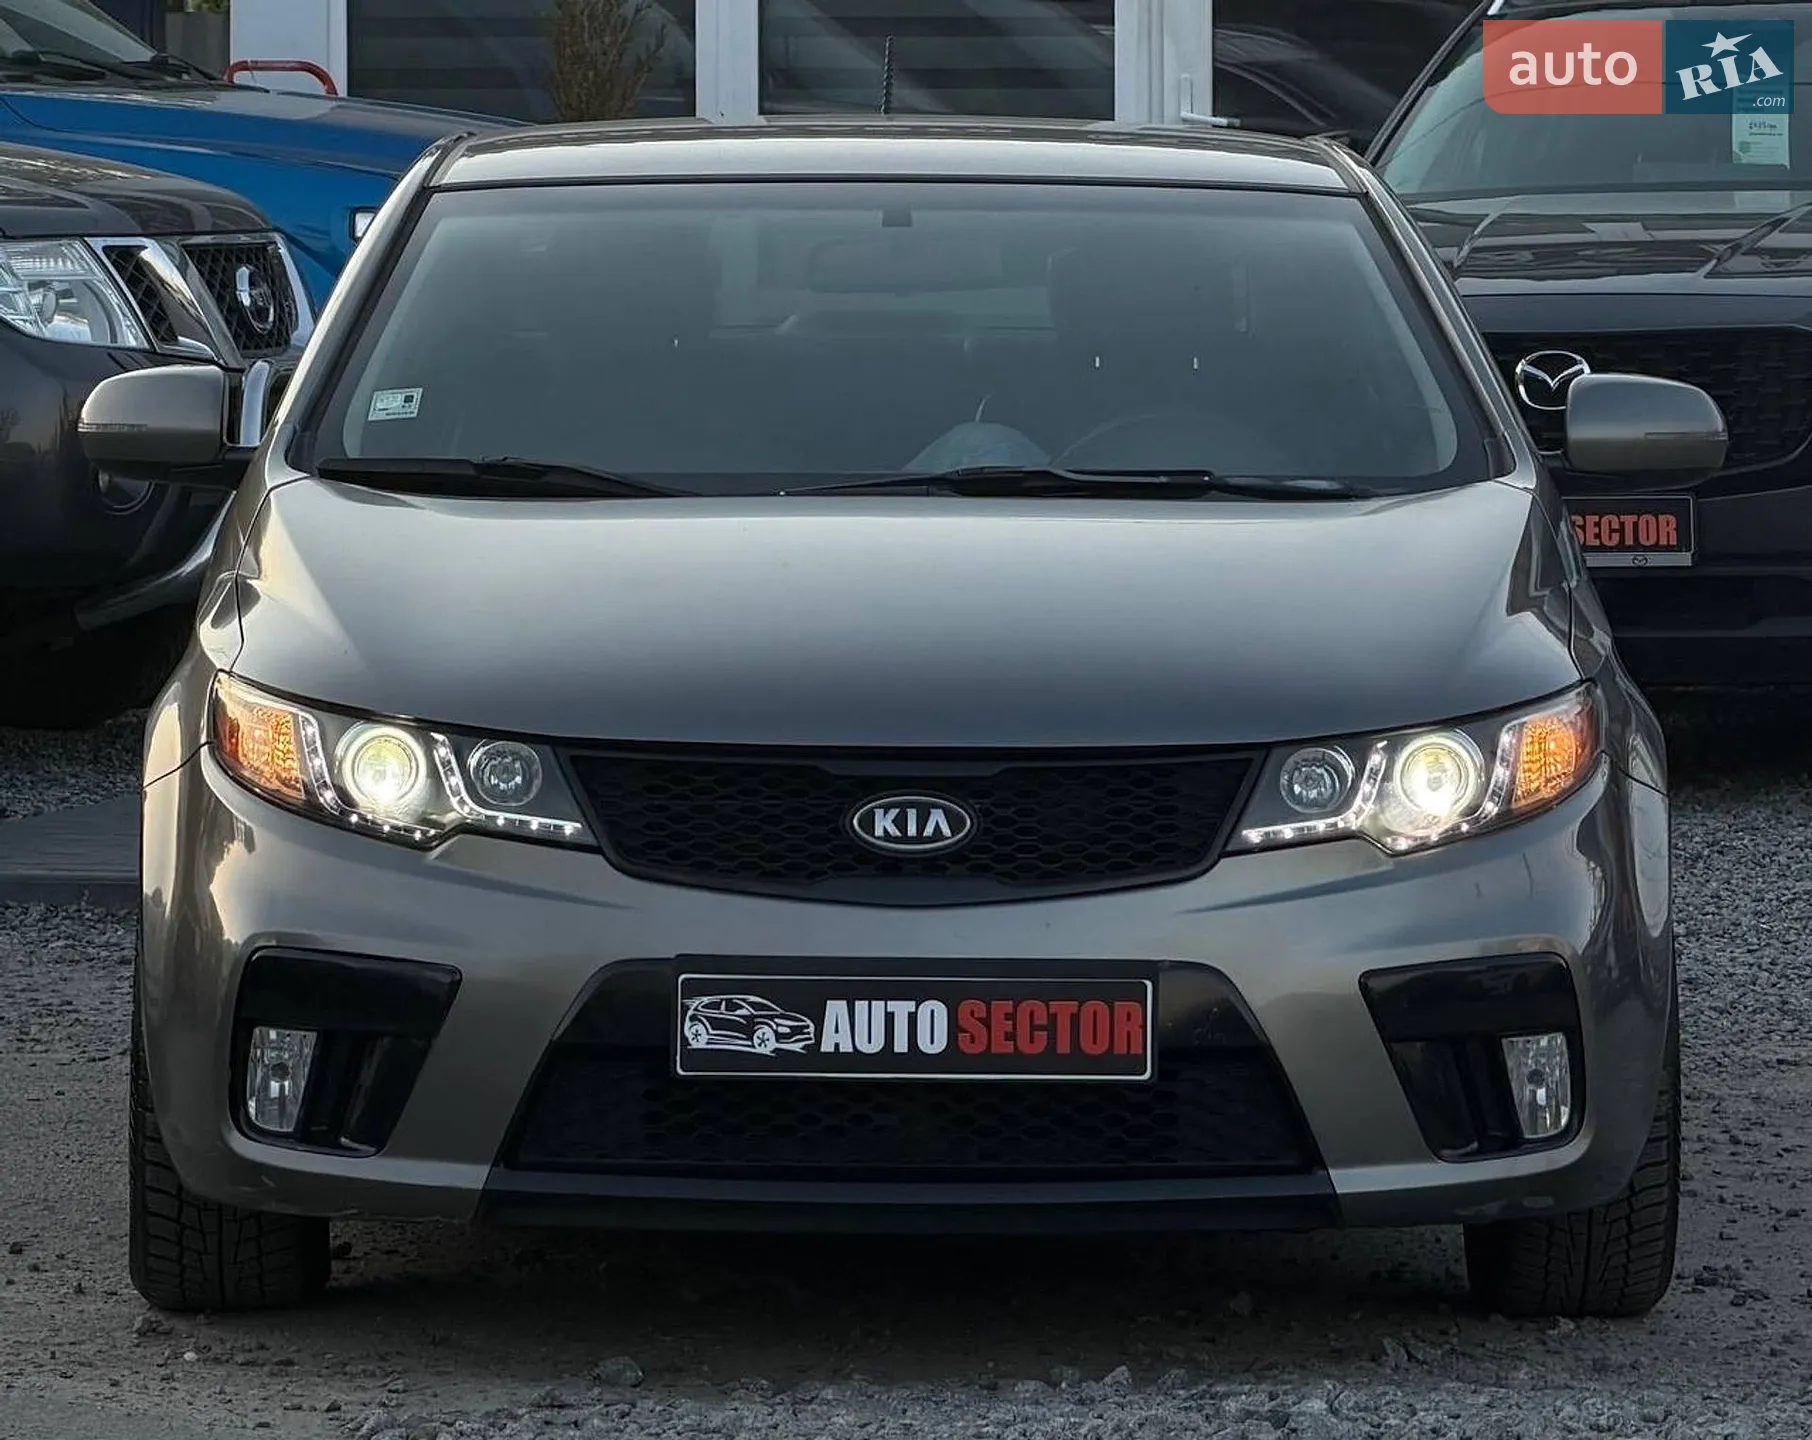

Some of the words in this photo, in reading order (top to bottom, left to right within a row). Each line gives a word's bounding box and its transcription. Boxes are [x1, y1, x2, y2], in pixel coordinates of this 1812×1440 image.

[1571, 514, 1677, 546] SECTOR
[873, 808, 952, 837] KIA
[819, 1000, 949, 1054] AUTO
[957, 1000, 1143, 1055] SECTOR
